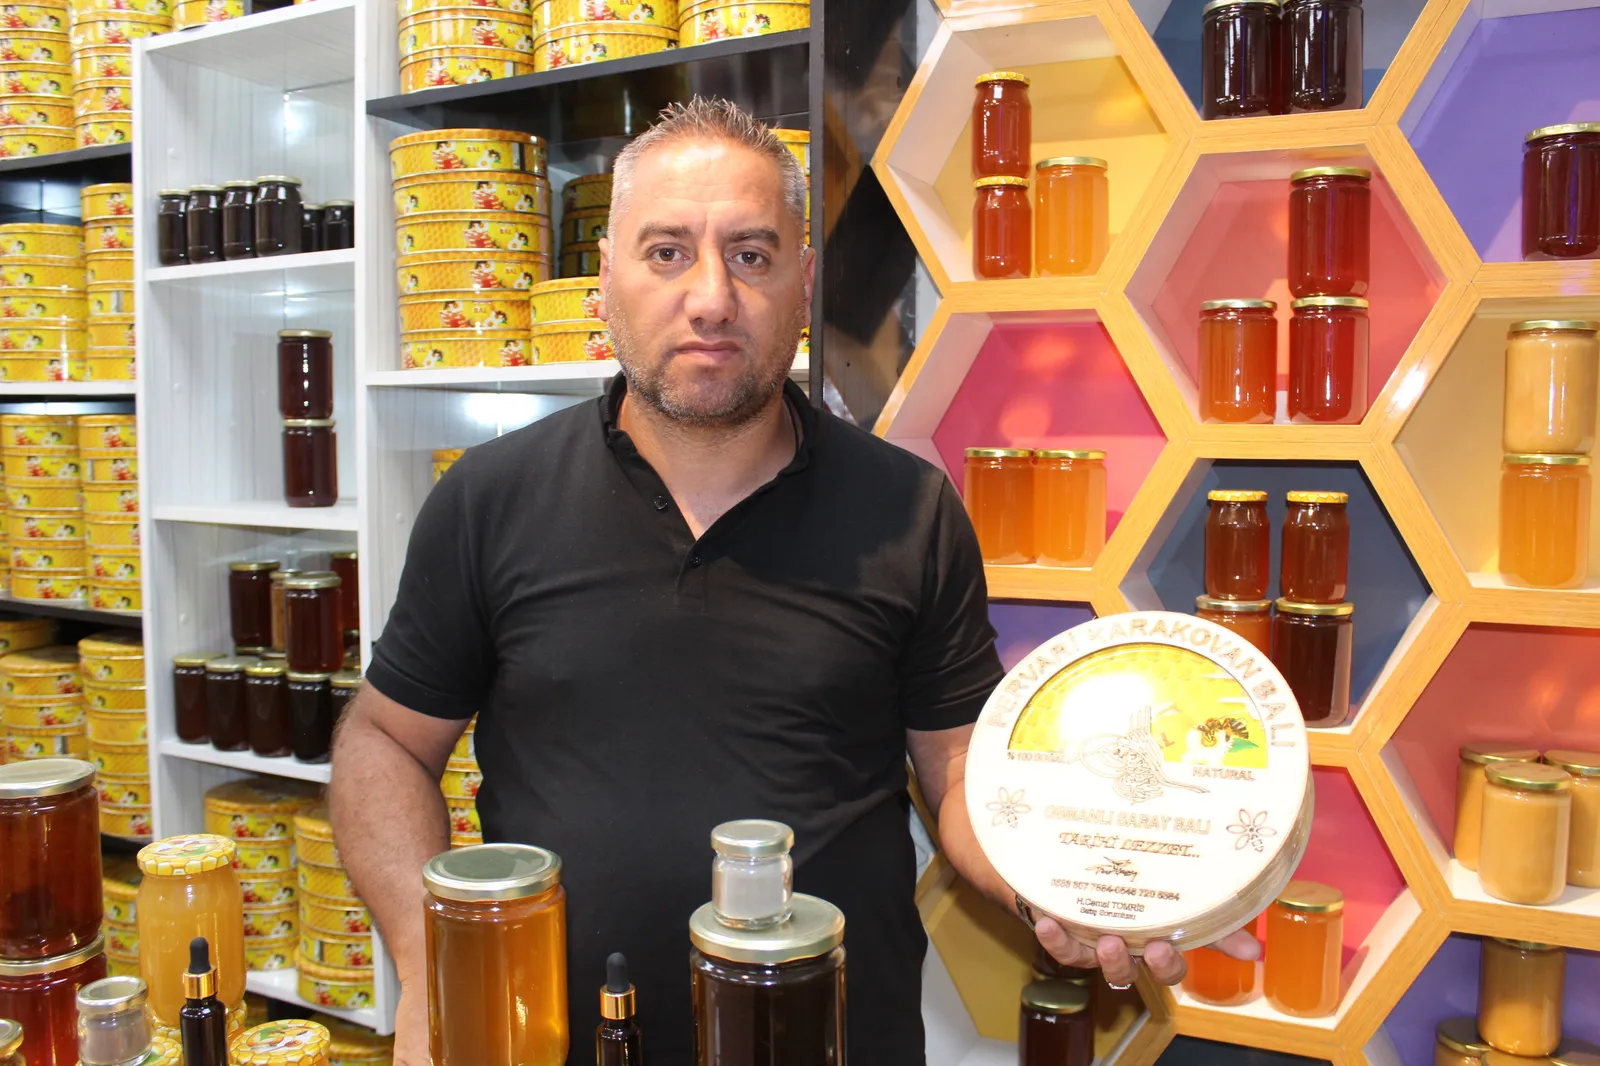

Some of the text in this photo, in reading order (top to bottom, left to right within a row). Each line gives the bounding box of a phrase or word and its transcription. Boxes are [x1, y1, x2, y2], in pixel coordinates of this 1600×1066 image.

[1087, 617, 1262, 682] KARAKOVAN
[1192, 767, 1256, 782] NATURAL
[1044, 805, 1211, 835] OSMANLI SARAY BALI
[1059, 831, 1120, 849] TARİHİ
[1111, 901, 1145, 912] TOMRİS
